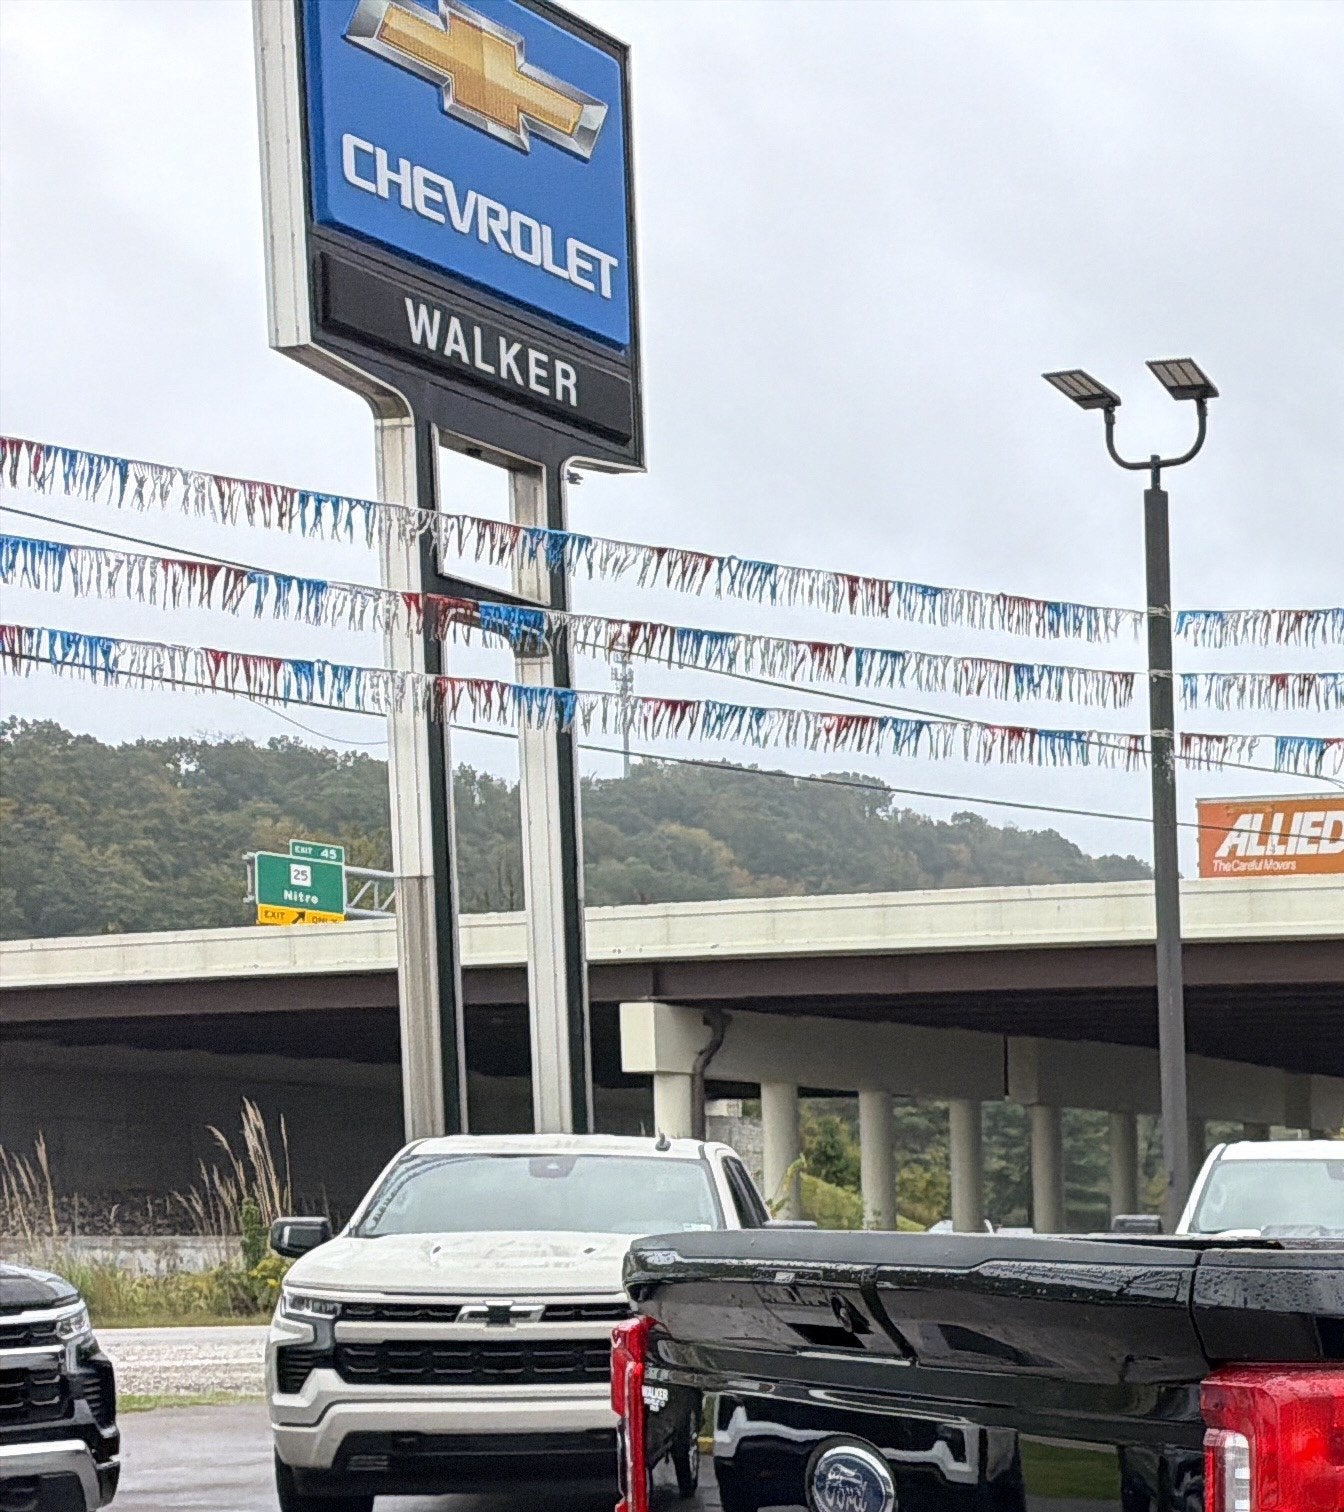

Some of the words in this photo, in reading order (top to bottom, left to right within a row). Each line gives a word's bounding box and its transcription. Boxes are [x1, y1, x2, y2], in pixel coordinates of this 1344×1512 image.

[341, 133, 619, 300] CHEVROLET
[404, 297, 579, 407] WALKER
[294, 845, 313, 855] EXIT
[320, 848, 338, 860] 45
[1212, 859, 1229, 872] The
[1230, 859, 1264, 872] Careful
[1263, 858, 1297, 871] Movers
[293, 868, 309, 882] 25
[283, 889, 319, 905] Nitro
[263, 909, 286, 920] EXIT
